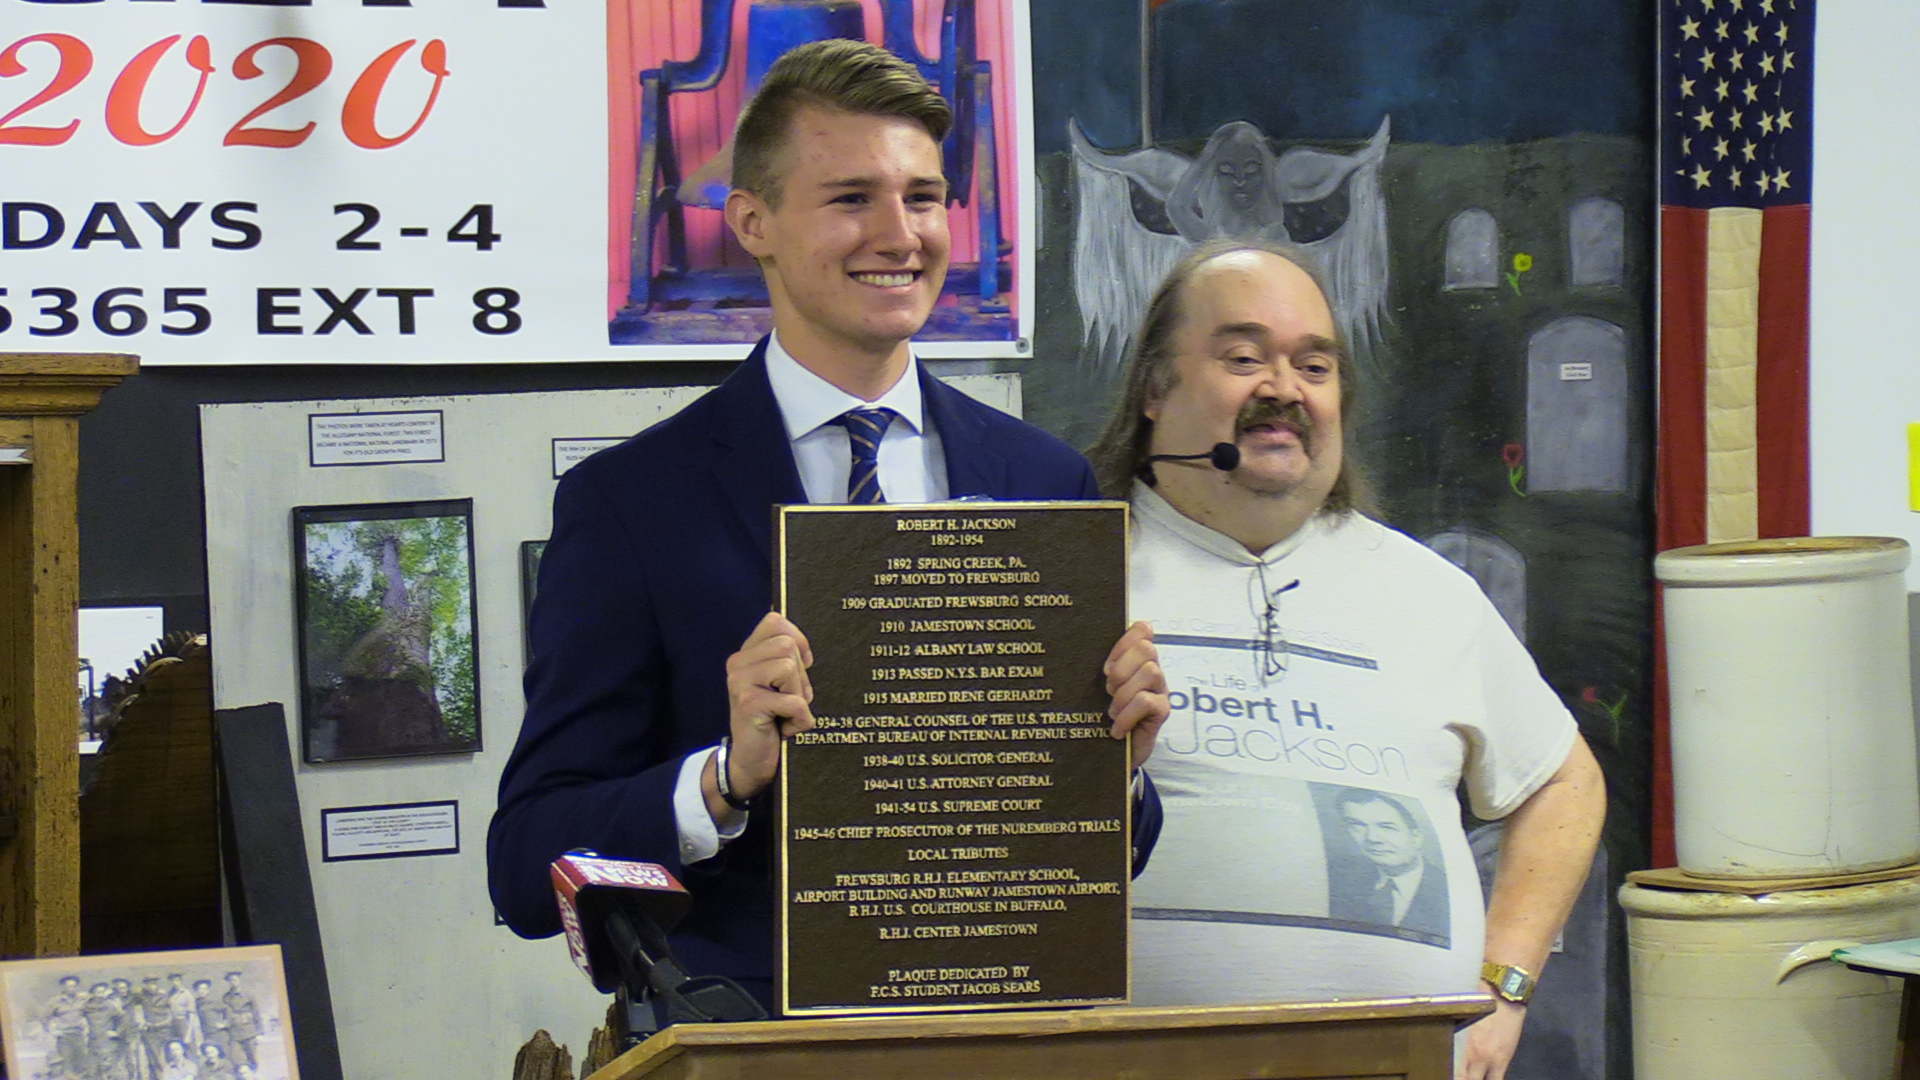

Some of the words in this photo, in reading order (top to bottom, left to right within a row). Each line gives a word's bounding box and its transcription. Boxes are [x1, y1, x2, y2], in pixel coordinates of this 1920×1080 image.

[0, 33, 450, 149] 2020
[333, 203, 501, 252] 2-4
[0, 287, 212, 336] 365
[256, 287, 435, 335] EXT
[471, 287, 522, 336] 8
[897, 519, 945, 530] ROBERT
[961, 519, 1016, 529] JACKSON
[931, 534, 984, 545] 1892-1954
[887, 558, 912, 569] 1892
[917, 558, 961, 569] SPRING
[874, 574, 899, 585] 1897
[901, 573, 946, 584] MOVED
[947, 573, 965, 584] TO
[967, 572, 1040, 583] FREWSBURG
[841, 598, 867, 609] 1909
[868, 597, 944, 608] GRADUATED
[945, 596, 1020, 607] FREWSBURG
[1024, 595, 1073, 606] SCHOOL
[880, 621, 905, 632] 1910
[909, 620, 985, 631] JAMESTOWN
[987, 619, 1036, 630] SCHOOL
[870, 645, 911, 656] 1911-12
[915, 644, 966, 655] ALBANY
[967, 643, 995, 654] LAW
[996, 643, 1046, 654] SCHOOL
[871, 669, 897, 680] 1913
[898, 668, 944, 679] PASSED
[980, 667, 1006, 678] BAR
[1008, 666, 1044, 677] EXAM
[1210, 673, 1246, 691] Life
[863, 693, 888, 703] 1915
[889, 692, 947, 703] MARRIED
[948, 691, 985, 702] IRENE
[987, 690, 1053, 701] GERHARDT
[1168, 687, 1280, 724] obert
[1291, 700, 1336, 731] H.
[855, 716, 912, 727] GENERAL
[913, 715, 969, 726] COUNSEL
[970, 714, 988, 725] OF
[989, 714, 1015, 725] THE
[1040, 713, 1103, 723] TREASURY
[795, 730, 875, 744] DEPARTMENT
[877, 731, 928, 742] BUREAU
[928, 731, 947, 741] OF
[949, 730, 1010, 740] INTERNAL
[1011, 729, 1068, 739] REVENUE
[1069, 728, 1112, 738] SERVIC
[1163, 704, 1410, 782] Jackson
[863, 755, 905, 766] 1938-40
[931, 753, 995, 765] SOLICITOR
[996, 752, 1054, 763] GENERAL
[863, 779, 904, 790] 1940-41
[930, 777, 995, 788] ATTORNEY
[996, 776, 1054, 787] GENERAL
[875, 803, 916, 813] 1941-54
[942, 800, 1000, 812] SUPREME
[1001, 799, 1043, 810] COURT
[794, 828, 836, 839] 1945-46
[837, 827, 874, 838] CHIEF
[875, 825, 956, 837] PROSECUTOR
[957, 824, 973, 835] OF
[974, 824, 999, 834] THE
[1001, 822, 1077, 834] NUREMBERG
[1079, 820, 1122, 832] TRIALS
[908, 849, 949, 860] LOCAL
[950, 848, 1009, 859] TRIBUTES
[836, 874, 911, 886] FREWSBURG
[946, 871, 1027, 883] ELEMENTARY
[794, 891, 847, 902] AIRPORT
[849, 889, 908, 901] BUILDING
[909, 888, 937, 899] AND
[939, 887, 991, 898] RUNWAY
[992, 885, 1066, 896] JAMESTOWN
[911, 902, 993, 914] COURTHOUSE
[994, 902, 1009, 911] IN
[913, 926, 962, 938] CENTER
[963, 924, 1038, 936] JAMESTOWN
[888, 969, 938, 982] PLAQUE
[939, 967, 1008, 980] DEDICATED
[1013, 966, 1030, 977] BY
[904, 984, 960, 996] STUDENT
[961, 983, 1001, 994] JACOB
[1002, 980, 1041, 993] SEARS
